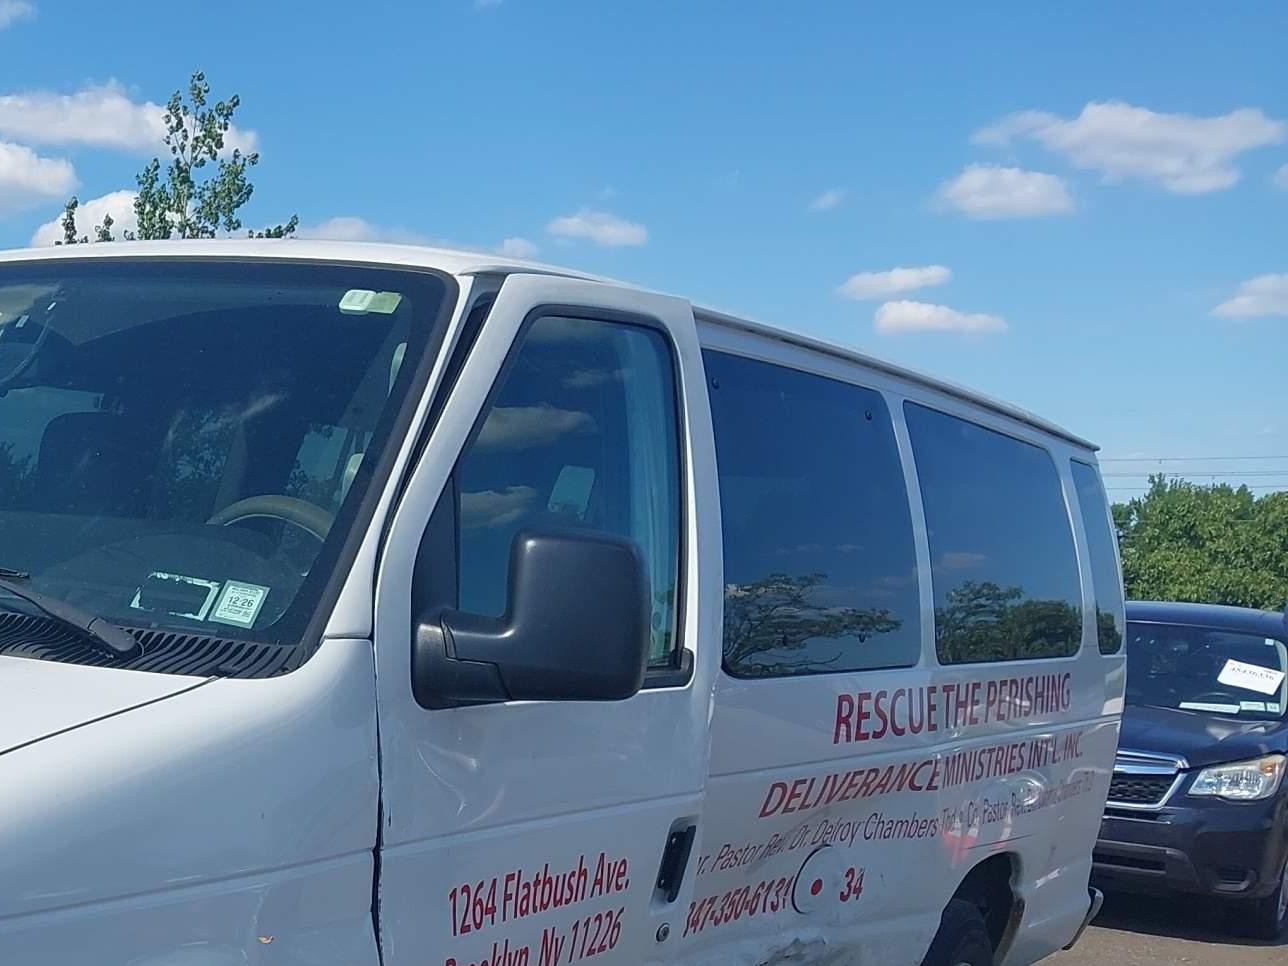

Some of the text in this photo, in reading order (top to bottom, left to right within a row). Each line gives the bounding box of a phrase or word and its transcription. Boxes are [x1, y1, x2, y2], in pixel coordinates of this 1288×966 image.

[833, 672, 1071, 745] RESCUE THE PERISHING
[758, 758, 941, 818] DELIVERANCE
[942, 742, 1025, 787] MINISTRIES
[711, 841, 762, 873] Pastor
[788, 824, 811, 852] Dr.
[811, 816, 862, 847] Delroy
[862, 812, 940, 842] Chambers
[448, 852, 630, 937] 1264 Flatbush Ave.
[567, 906, 625, 964] 11226
